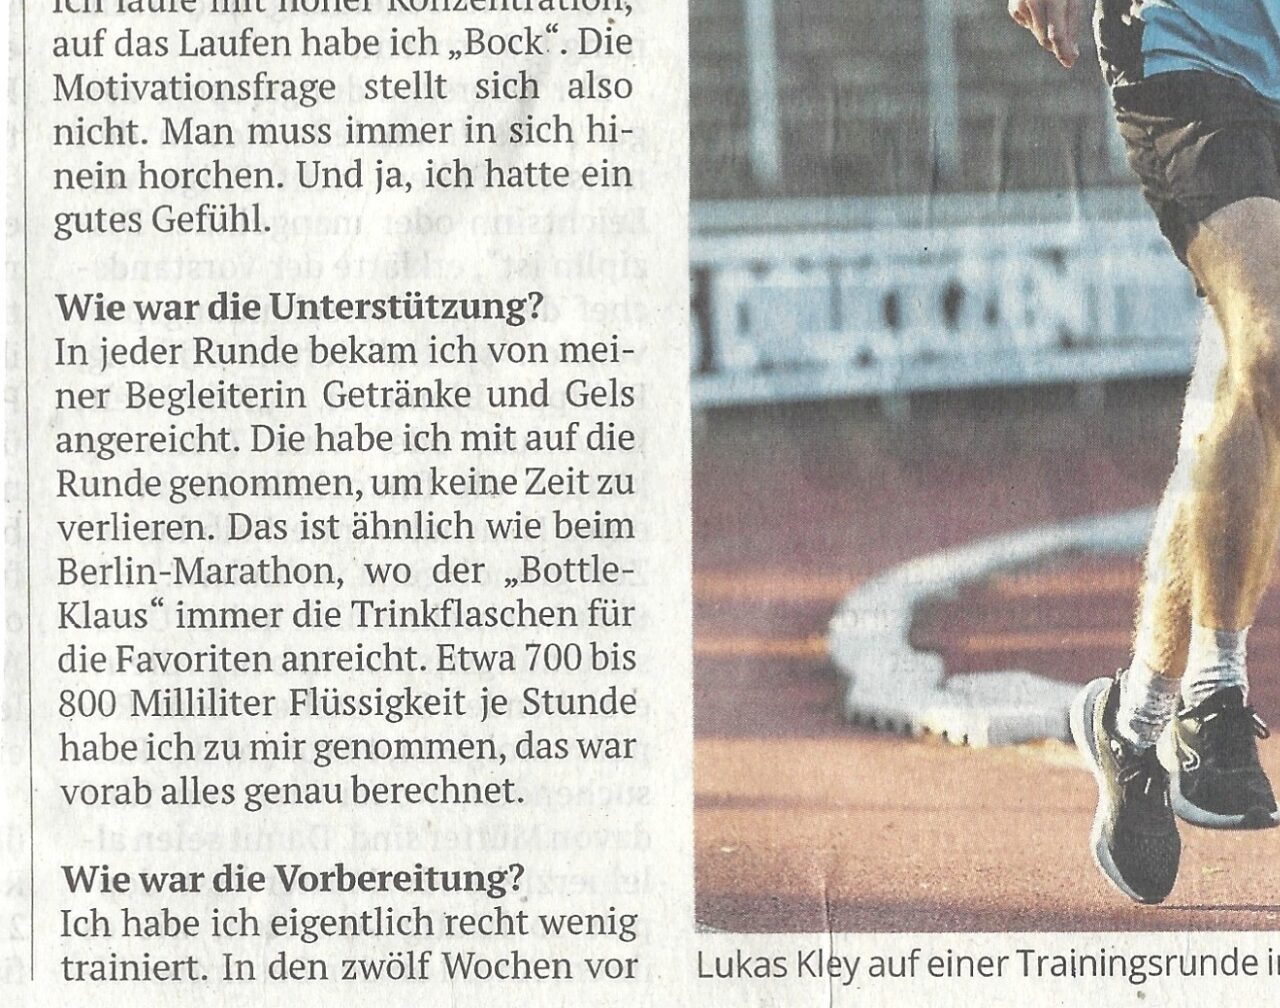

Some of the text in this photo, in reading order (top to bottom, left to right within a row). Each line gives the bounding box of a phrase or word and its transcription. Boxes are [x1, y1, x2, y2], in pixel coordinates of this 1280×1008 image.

[53, 69, 633, 108] Motivationsfrage stellt sich also
[54, 292, 126, 321] Wie
[133, 300, 201, 321] war
[208, 290, 261, 321] die
[269, 291, 544, 327] Unterstützung?
[57, 554, 344, 590] Berlin-Marathon,
[364, 563, 411, 584] wo
[432, 554, 486, 584] der
[58, 685, 637, 724] 800 Milliliter Flüssigkeit je Stunde
[61, 864, 131, 893] Wie
[138, 872, 205, 893] war
[212, 863, 266, 893] die
[273, 862, 525, 899] Vorbereitung?
[61, 950, 639, 982] trainiert. In den zwölf Wochen vor
[698, 949, 788, 979] Lukas
[798, 948, 861, 986] Kley
[868, 948, 922, 978] auf
[927, 948, 1010, 978] einer
[1015, 946, 1259, 985] Trainingsrunde
